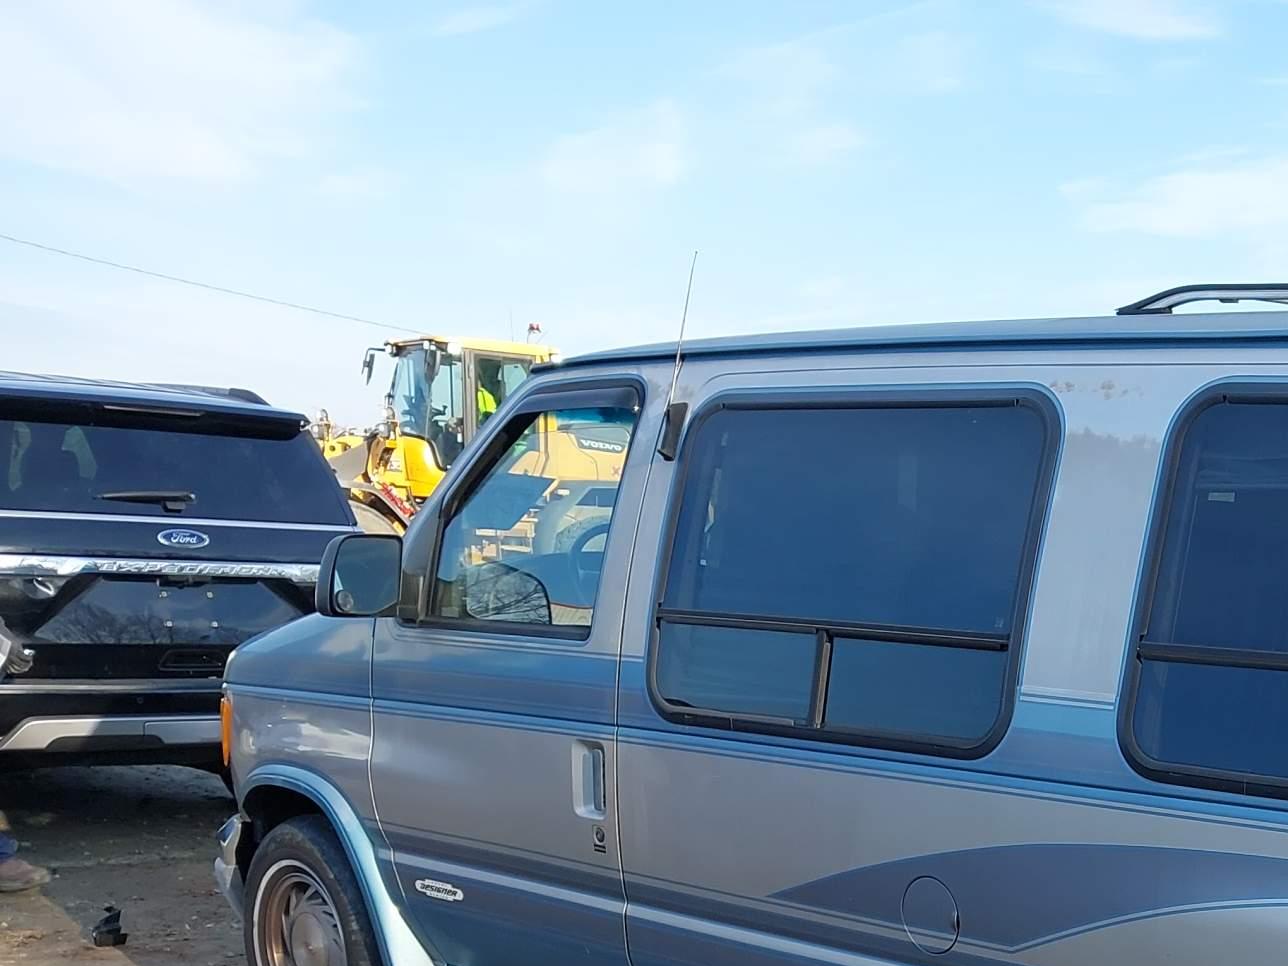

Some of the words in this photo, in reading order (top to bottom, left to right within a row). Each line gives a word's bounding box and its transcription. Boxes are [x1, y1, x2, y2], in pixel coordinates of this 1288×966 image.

[580, 439, 623, 452] VOLVO
[99, 560, 277, 577] EXPEDITION
[419, 882, 458, 897] DESIGNER
